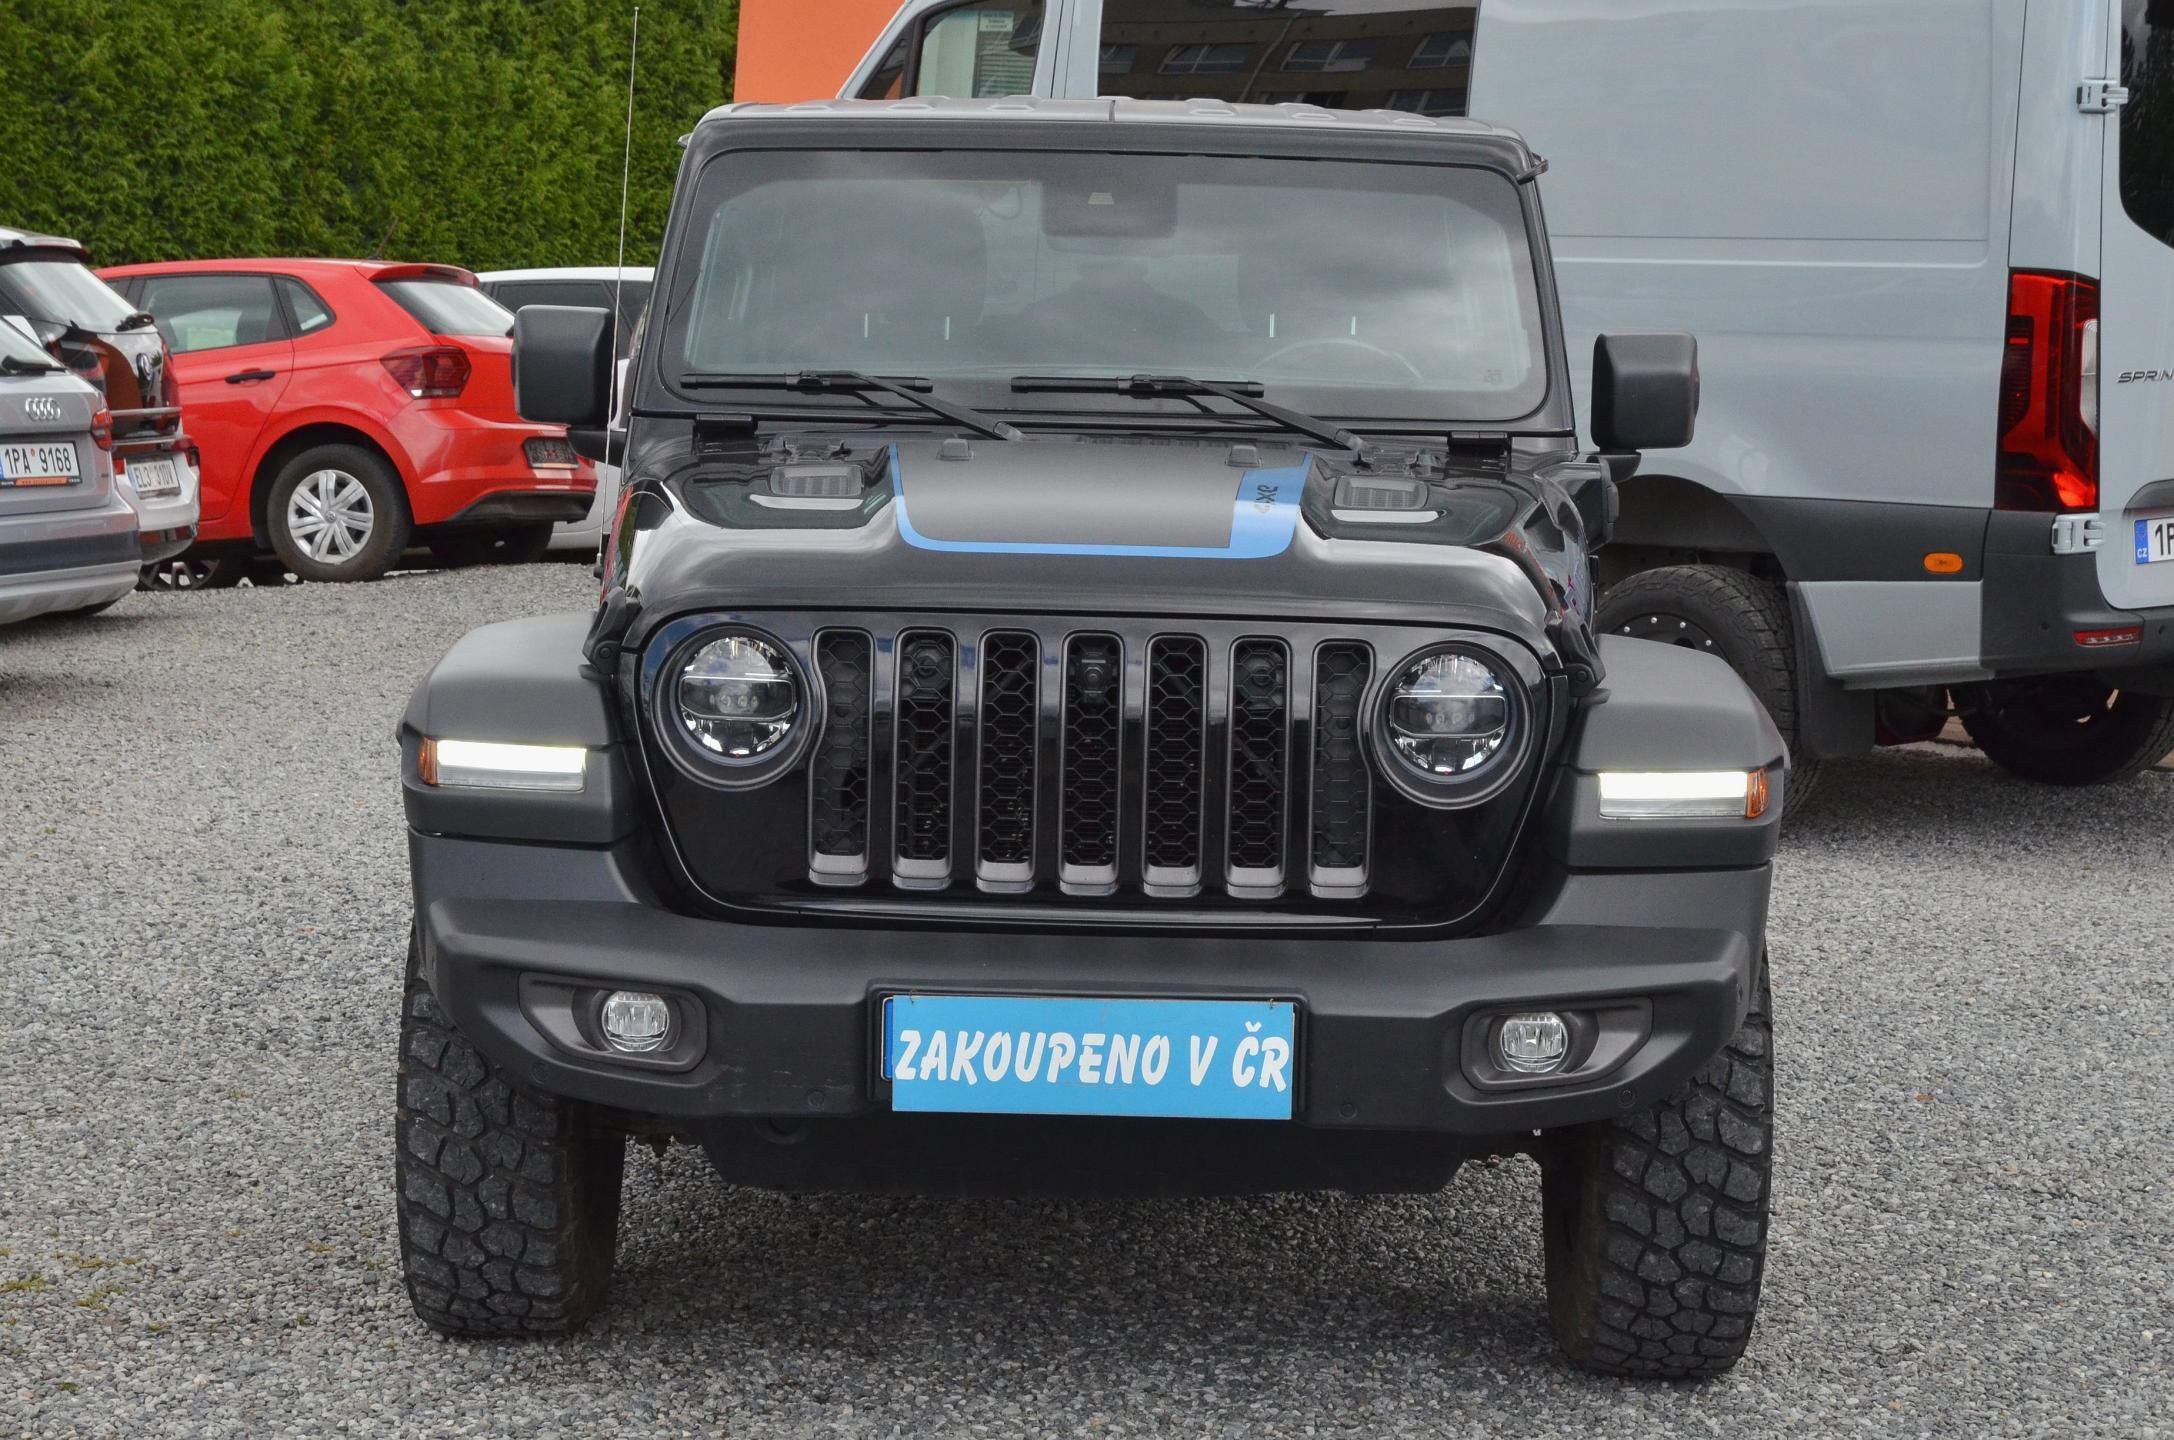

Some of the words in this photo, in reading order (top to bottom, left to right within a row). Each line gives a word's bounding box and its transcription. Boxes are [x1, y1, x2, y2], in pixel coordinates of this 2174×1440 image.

[5, 447, 31, 475] 1PA
[39, 447, 72, 473] 9168
[2137, 547, 2148, 558] CZ
[894, 1029, 1170, 1085] ZAKOUPENO
[1189, 1035, 1218, 1086] V
[1232, 1021, 1290, 1093] ČR
